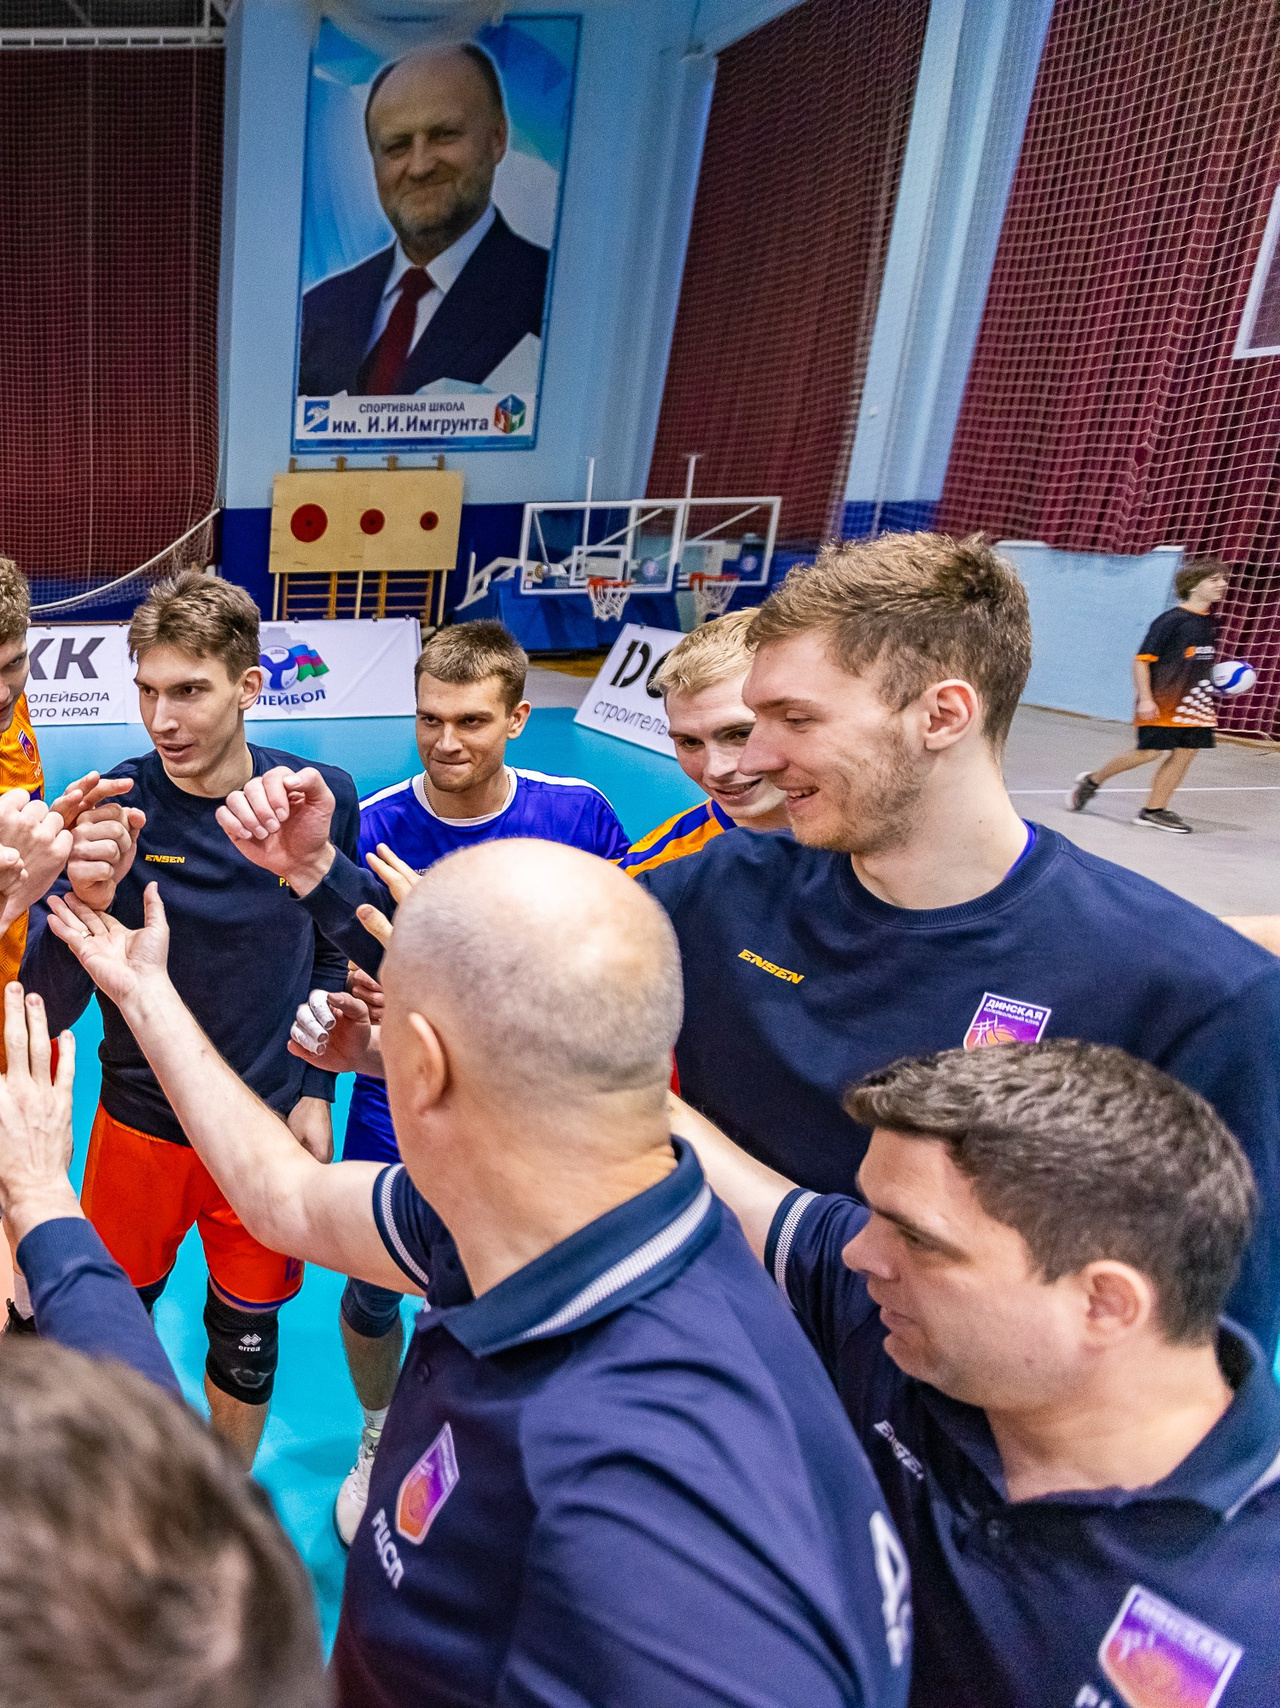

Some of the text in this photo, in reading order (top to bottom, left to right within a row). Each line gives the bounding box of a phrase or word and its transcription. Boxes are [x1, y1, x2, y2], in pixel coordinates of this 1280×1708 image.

[358, 401, 466, 414] СПОРТИВНАЯ ШКОЛА
[332, 415, 489, 435] им. И.И.Имгрунта
[27, 690, 111, 704] ОЛЕЙБОЛА
[256, 688, 327, 706] ЛЕЙБОЛ
[29, 706, 100, 719] ОГО КРАЯ
[593, 700, 669, 736] строитель
[145, 854, 185, 864] ENSEN
[737, 949, 804, 984] ENSEN
[985, 998, 1044, 1021] ДИНСКАЯ
